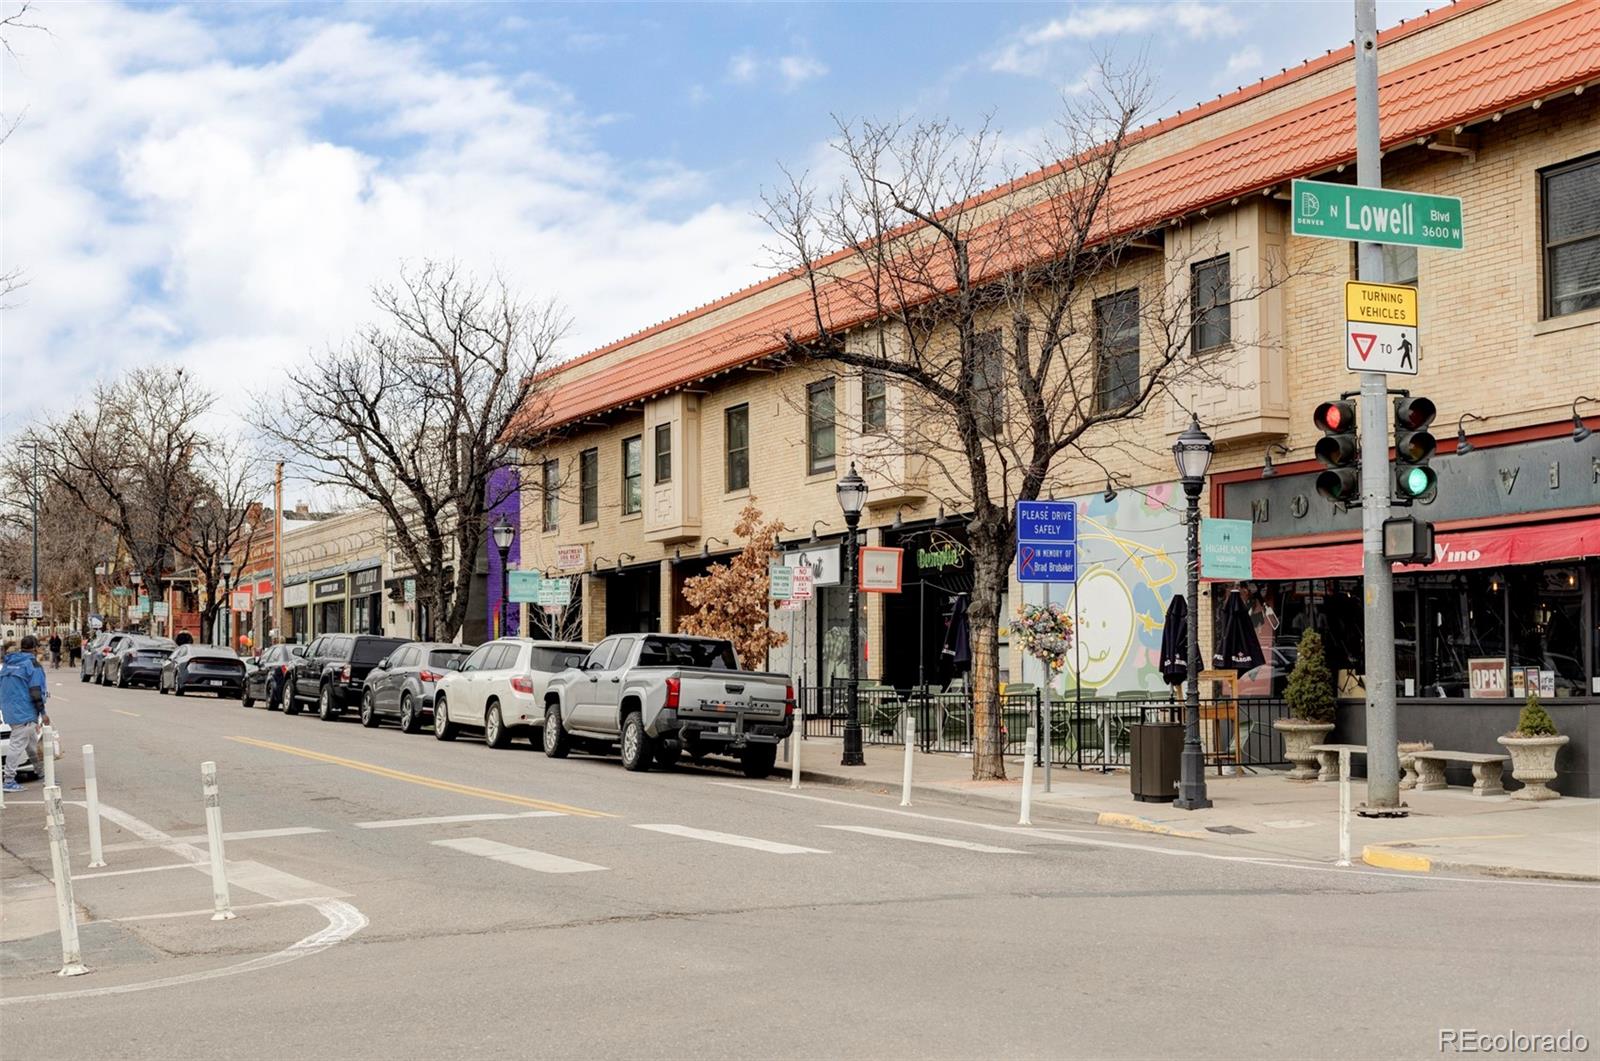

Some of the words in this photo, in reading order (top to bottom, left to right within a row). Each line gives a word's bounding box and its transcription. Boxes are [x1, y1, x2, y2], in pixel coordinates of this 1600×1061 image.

[1330, 206, 1338, 217] N
[1345, 195, 1414, 236] Lowell
[1430, 210, 1450, 223] Blvd
[1297, 217, 1325, 226] DENVER
[1422, 225, 1449, 239] 3600
[1452, 228, 1461, 239] W
[1361, 290, 1403, 304] TURNING
[1359, 306, 1406, 320] VEHICLES
[1380, 343, 1392, 354] TO
[1021, 510, 1049, 520] PLEASE
[1051, 511, 1072, 521] DRIVE
[1034, 525, 1061, 535] SAFELY
[1035, 549, 1041, 557] IN
[1043, 549, 1063, 557] MEMORY
[1065, 549, 1072, 557] OF
[1205, 543, 1248, 554] HIGHLAND
[1434, 543, 1481, 563] Vino
[1034, 562, 1048, 572] Brad
[1049, 562, 1074, 572] Brubaker
[1472, 668, 1504, 690] OPEN
